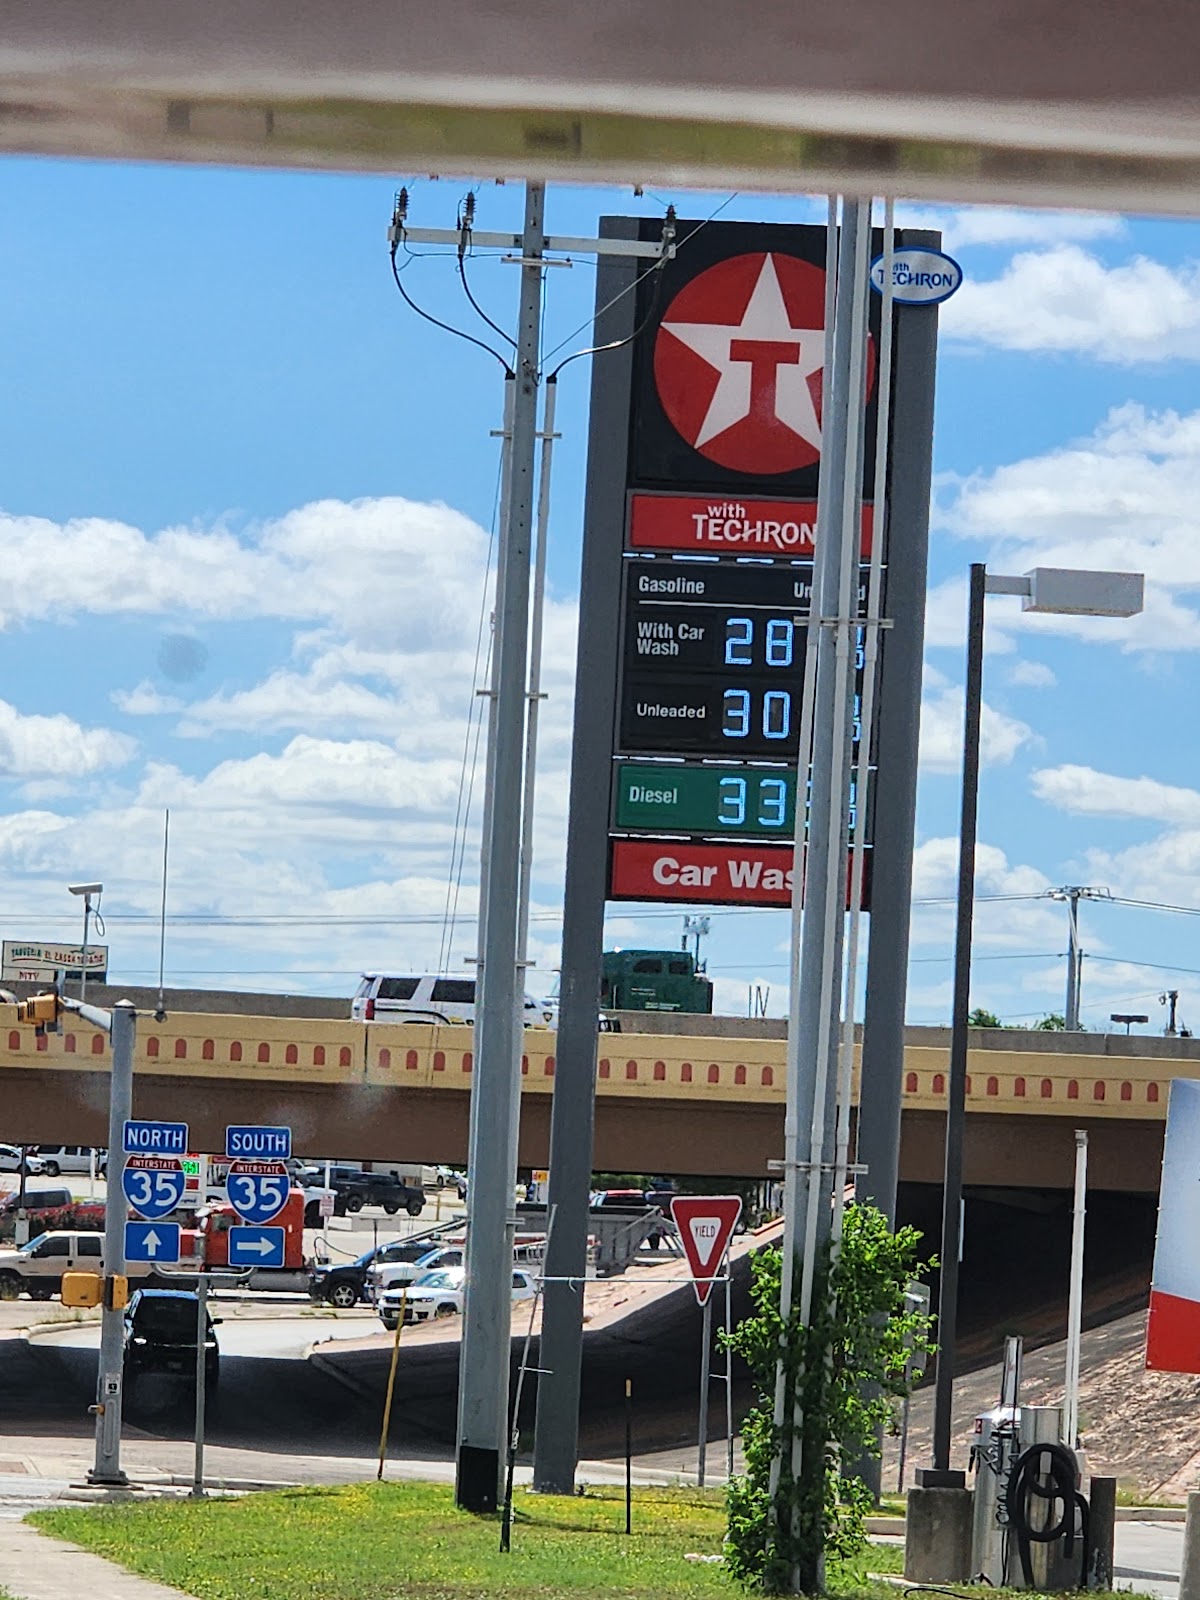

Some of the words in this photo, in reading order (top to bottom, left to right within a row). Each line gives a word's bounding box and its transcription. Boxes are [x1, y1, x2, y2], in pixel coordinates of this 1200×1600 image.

[892, 262, 910, 272] ith
[707, 502, 746, 519] with
[692, 514, 817, 550] TECHRON
[638, 575, 705, 595] Gasoline
[637, 621, 674, 639] With
[678, 622, 705, 640] Car
[637, 638, 679, 656] Wash
[724, 617, 794, 667] 28
[636, 702, 706, 719] Unleaded
[722, 688, 791, 740] 30
[629, 785, 678, 804] Diesel
[717, 777, 813, 827] 33
[652, 857, 717, 887] Car
[127, 1128, 183, 1148] NORTH
[231, 1133, 287, 1152] SOUTH
[132, 1159, 176, 1170] INTERSTATE
[236, 1164, 280, 1174] INTERSTATE
[129, 1171, 178, 1207] 35
[234, 1176, 282, 1211] 35
[695, 1225, 716, 1238] YIELD
